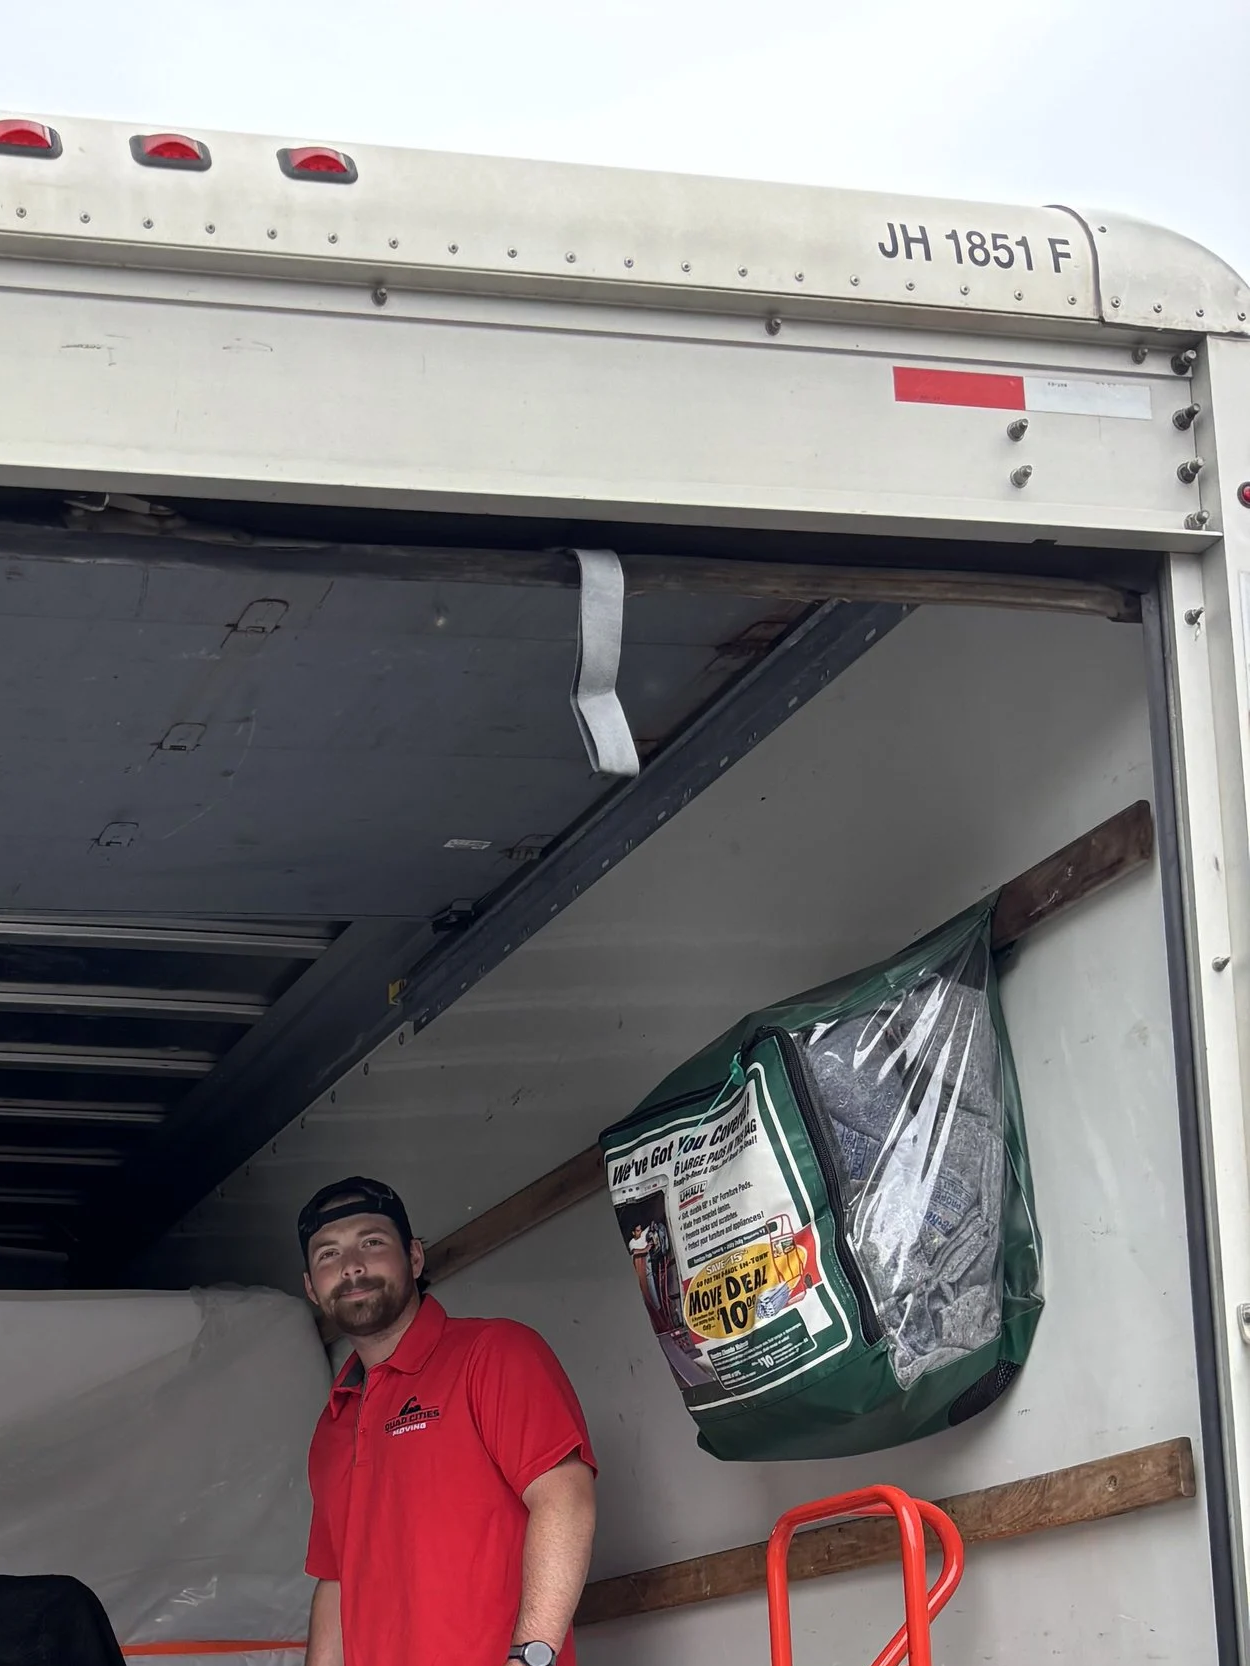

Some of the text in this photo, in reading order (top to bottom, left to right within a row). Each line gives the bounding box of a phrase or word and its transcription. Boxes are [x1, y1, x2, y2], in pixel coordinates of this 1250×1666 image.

[877, 222, 1072, 274] JH 1851 F
[612, 1154, 649, 1187] We've
[651, 1140, 674, 1169] Got
[677, 1134, 708, 1156] You
[673, 1160, 680, 1177] 6
[681, 1153, 707, 1174] LARGE
[706, 1144, 727, 1165] PADS
[732, 1210, 765, 1231] appliances!
[696, 1280, 703, 1288] GO
[739, 1251, 769, 1270] IN-TOWN
[706, 1260, 727, 1275] SAVE
[689, 1264, 768, 1317] MOVE DEAL
[385, 1409, 440, 1431] QUAD CITIES
[392, 1422, 427, 1437] MOVING
